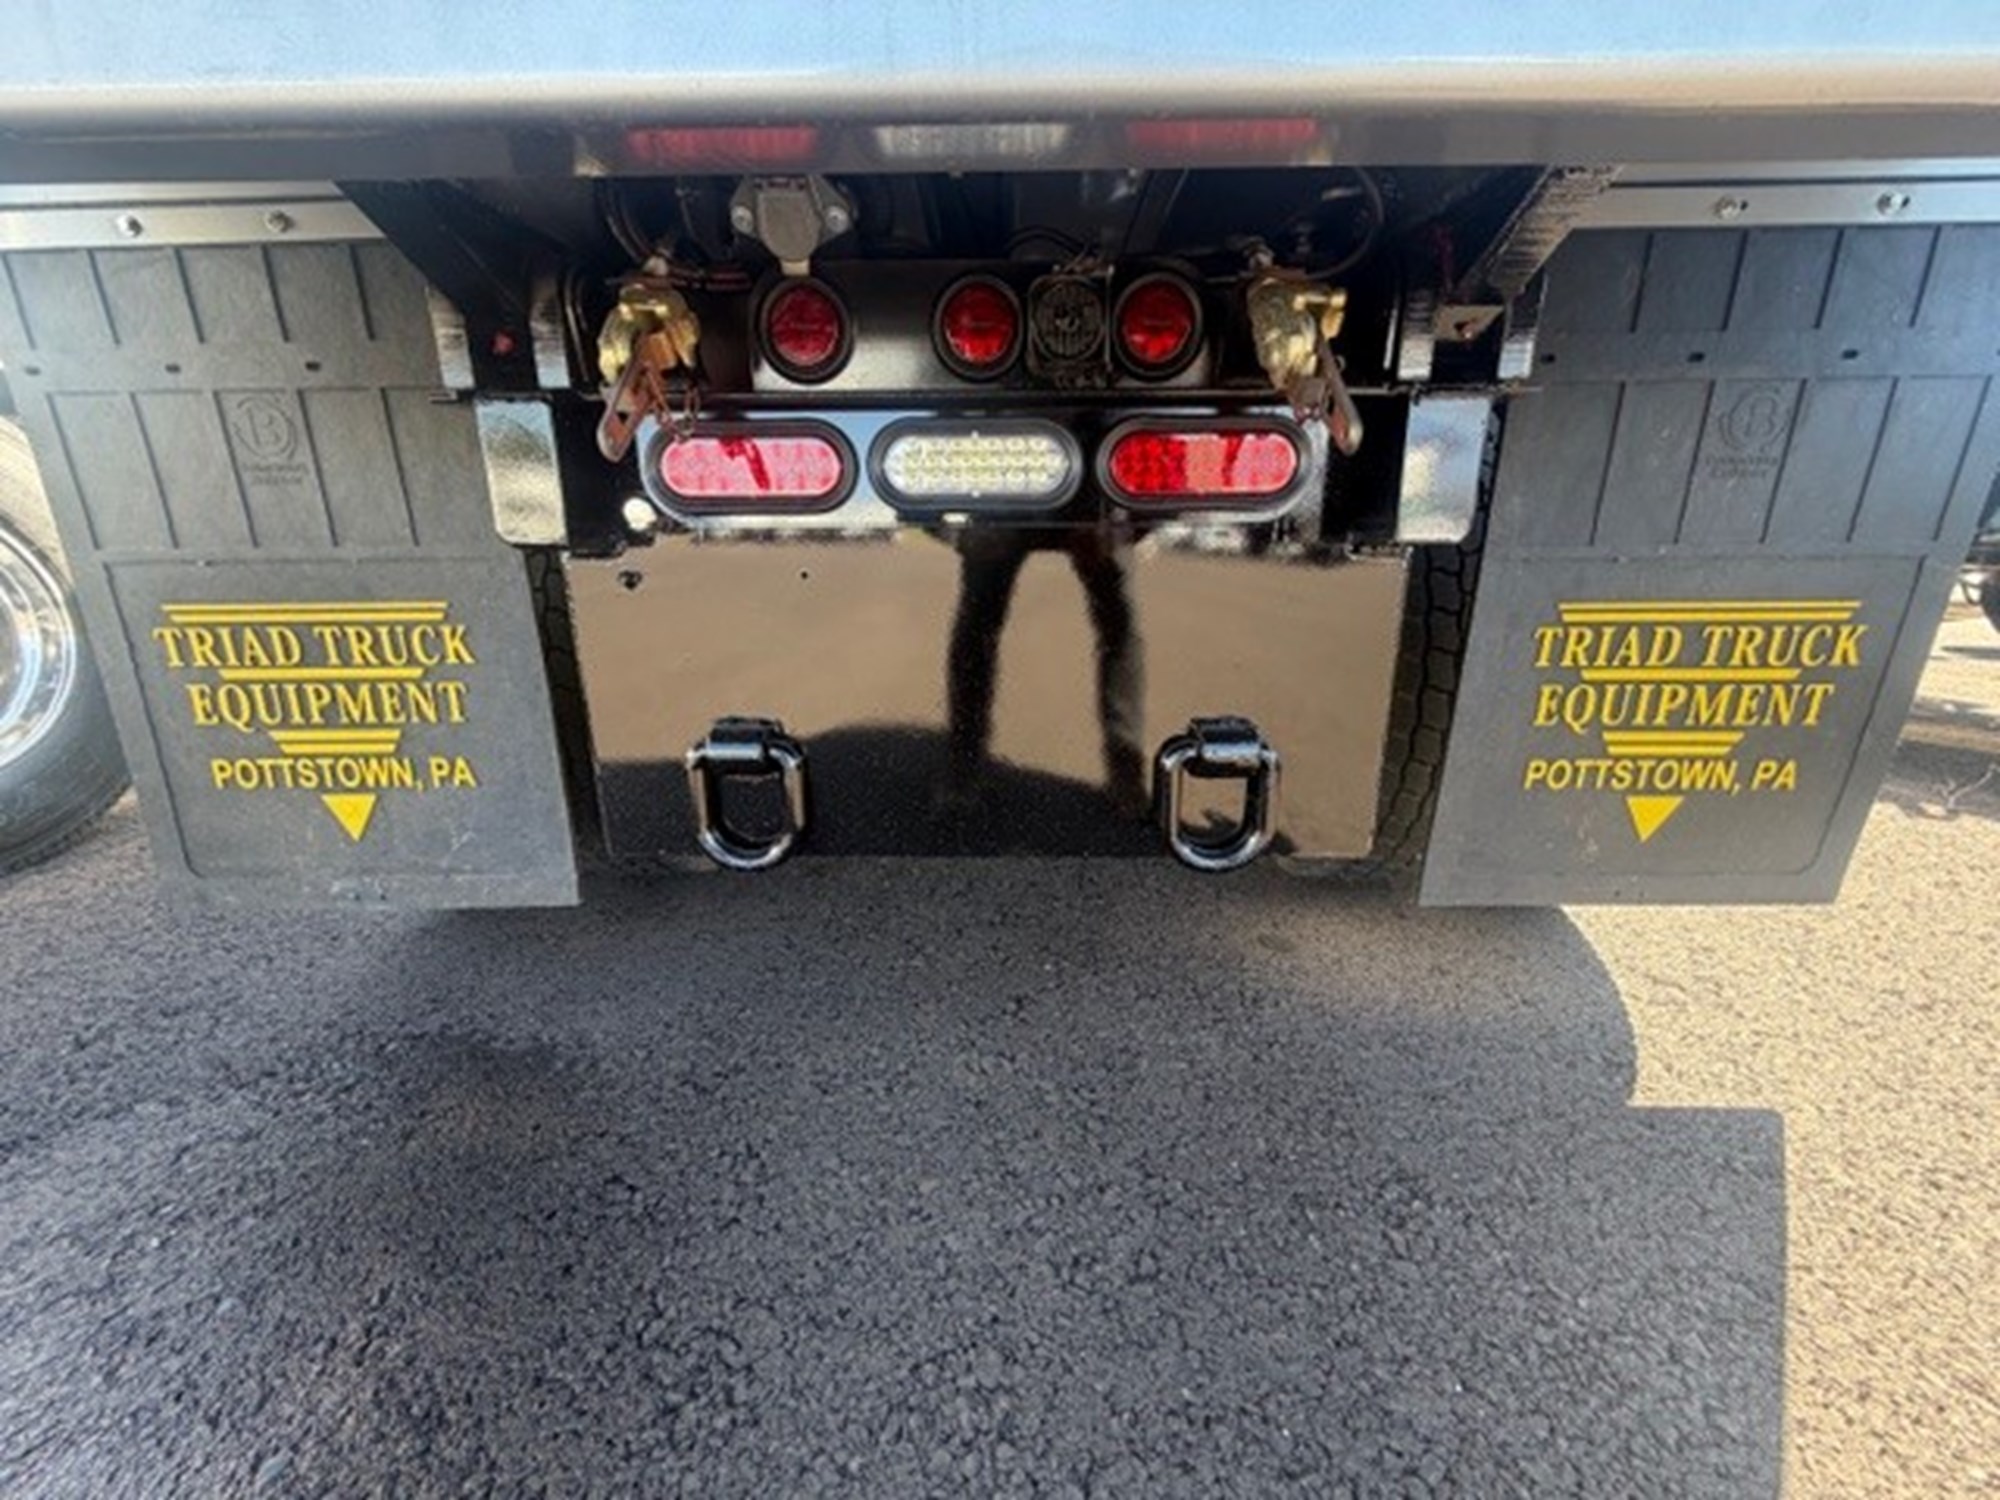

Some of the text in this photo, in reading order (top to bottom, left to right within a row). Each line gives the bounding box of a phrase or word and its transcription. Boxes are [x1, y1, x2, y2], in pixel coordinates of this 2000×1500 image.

[153, 624, 475, 667] TRIAD TRUCK
[1534, 624, 1868, 668] TRIAD TRUCK
[186, 681, 468, 732] EQUIPMENT
[1533, 683, 1834, 733] EQUIPMENT
[210, 755, 477, 793] POTTSTOWN, PA
[1523, 758, 1798, 795] POTTSTOWN, PA
